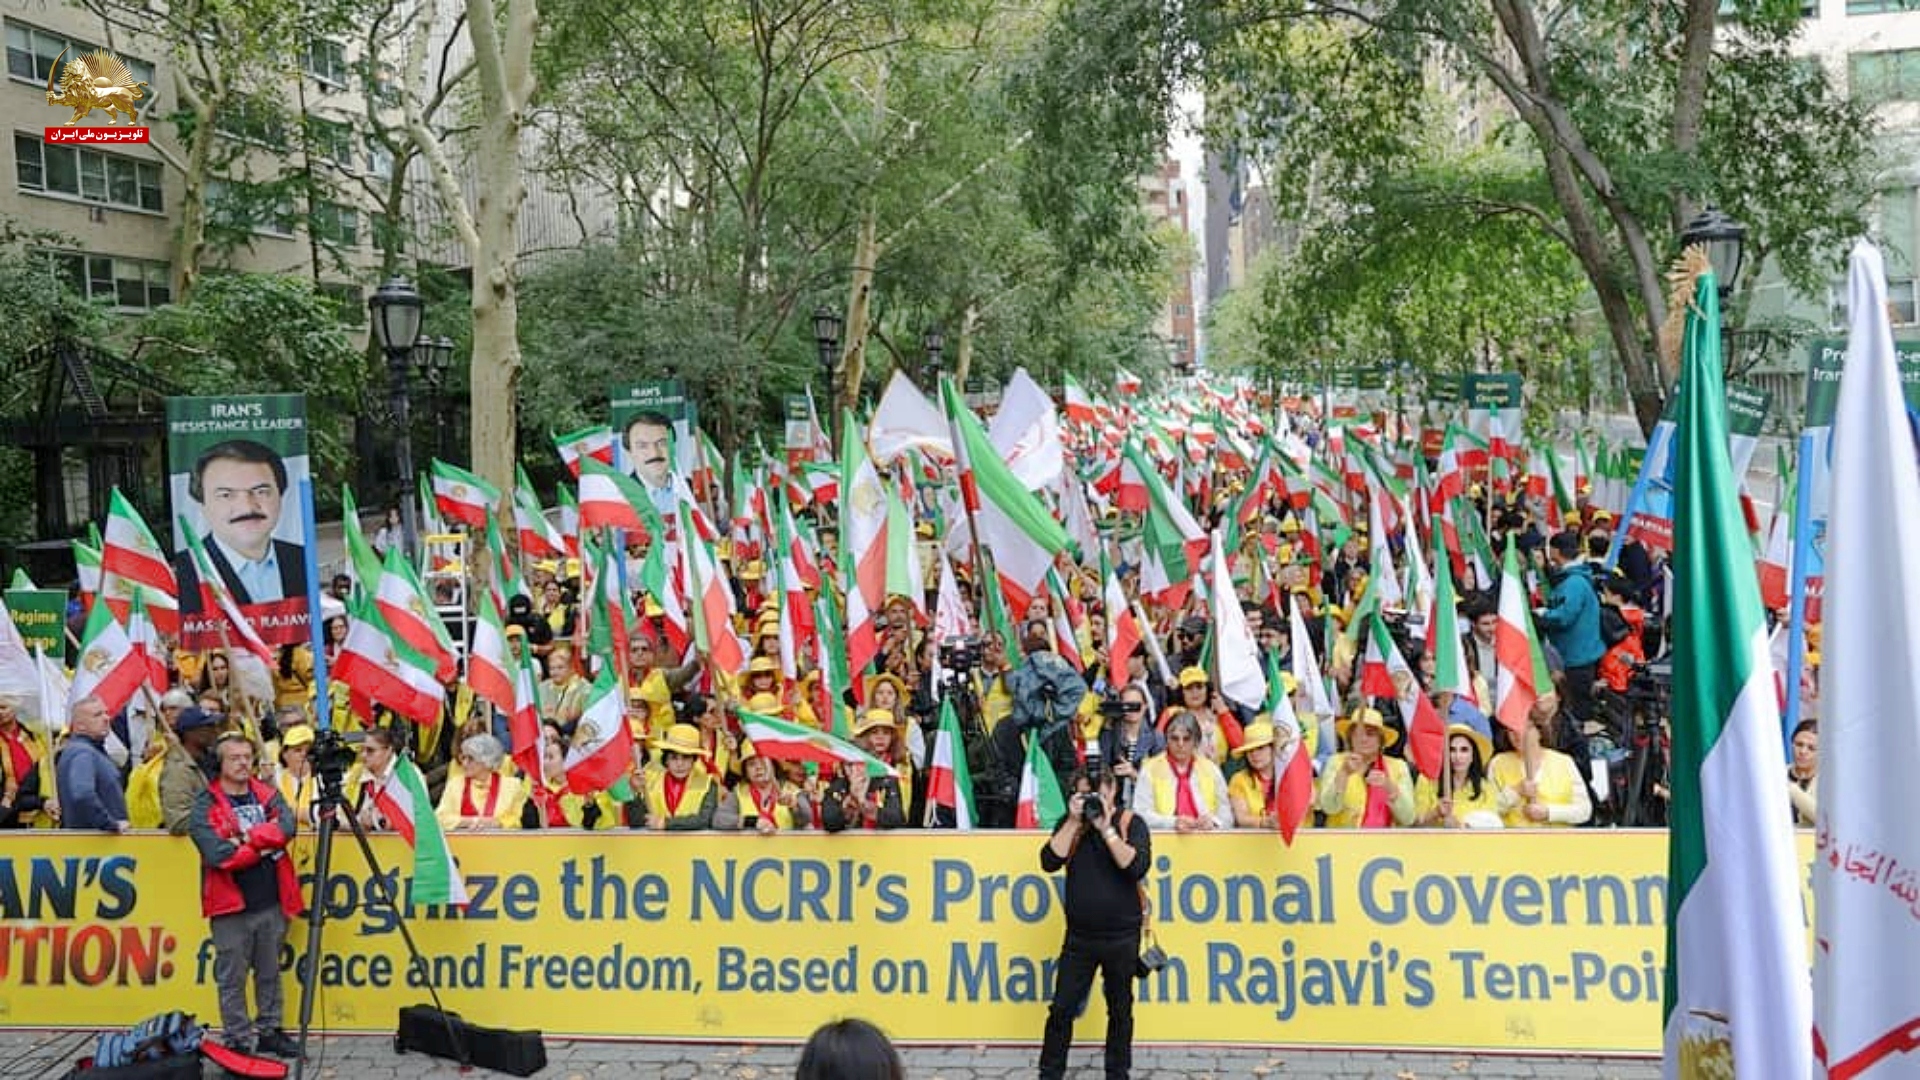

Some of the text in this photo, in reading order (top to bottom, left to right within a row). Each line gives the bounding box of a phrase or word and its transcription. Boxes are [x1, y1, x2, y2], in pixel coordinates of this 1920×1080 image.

[170, 417, 302, 433] RESISTANCE LEADER
[211, 403, 262, 418] IRAN'S
[561, 855, 668, 921] the
[691, 858, 909, 923] NCRI's
[932, 854, 1335, 925] Proional
[406, 942, 486, 988] and
[501, 943, 702, 995] Freedom,
[716, 945, 858, 994] Based
[873, 957, 928, 994] on
[1207, 941, 1435, 1021] Rajavi's
[1449, 948, 1665, 1002] Ten-Poi
